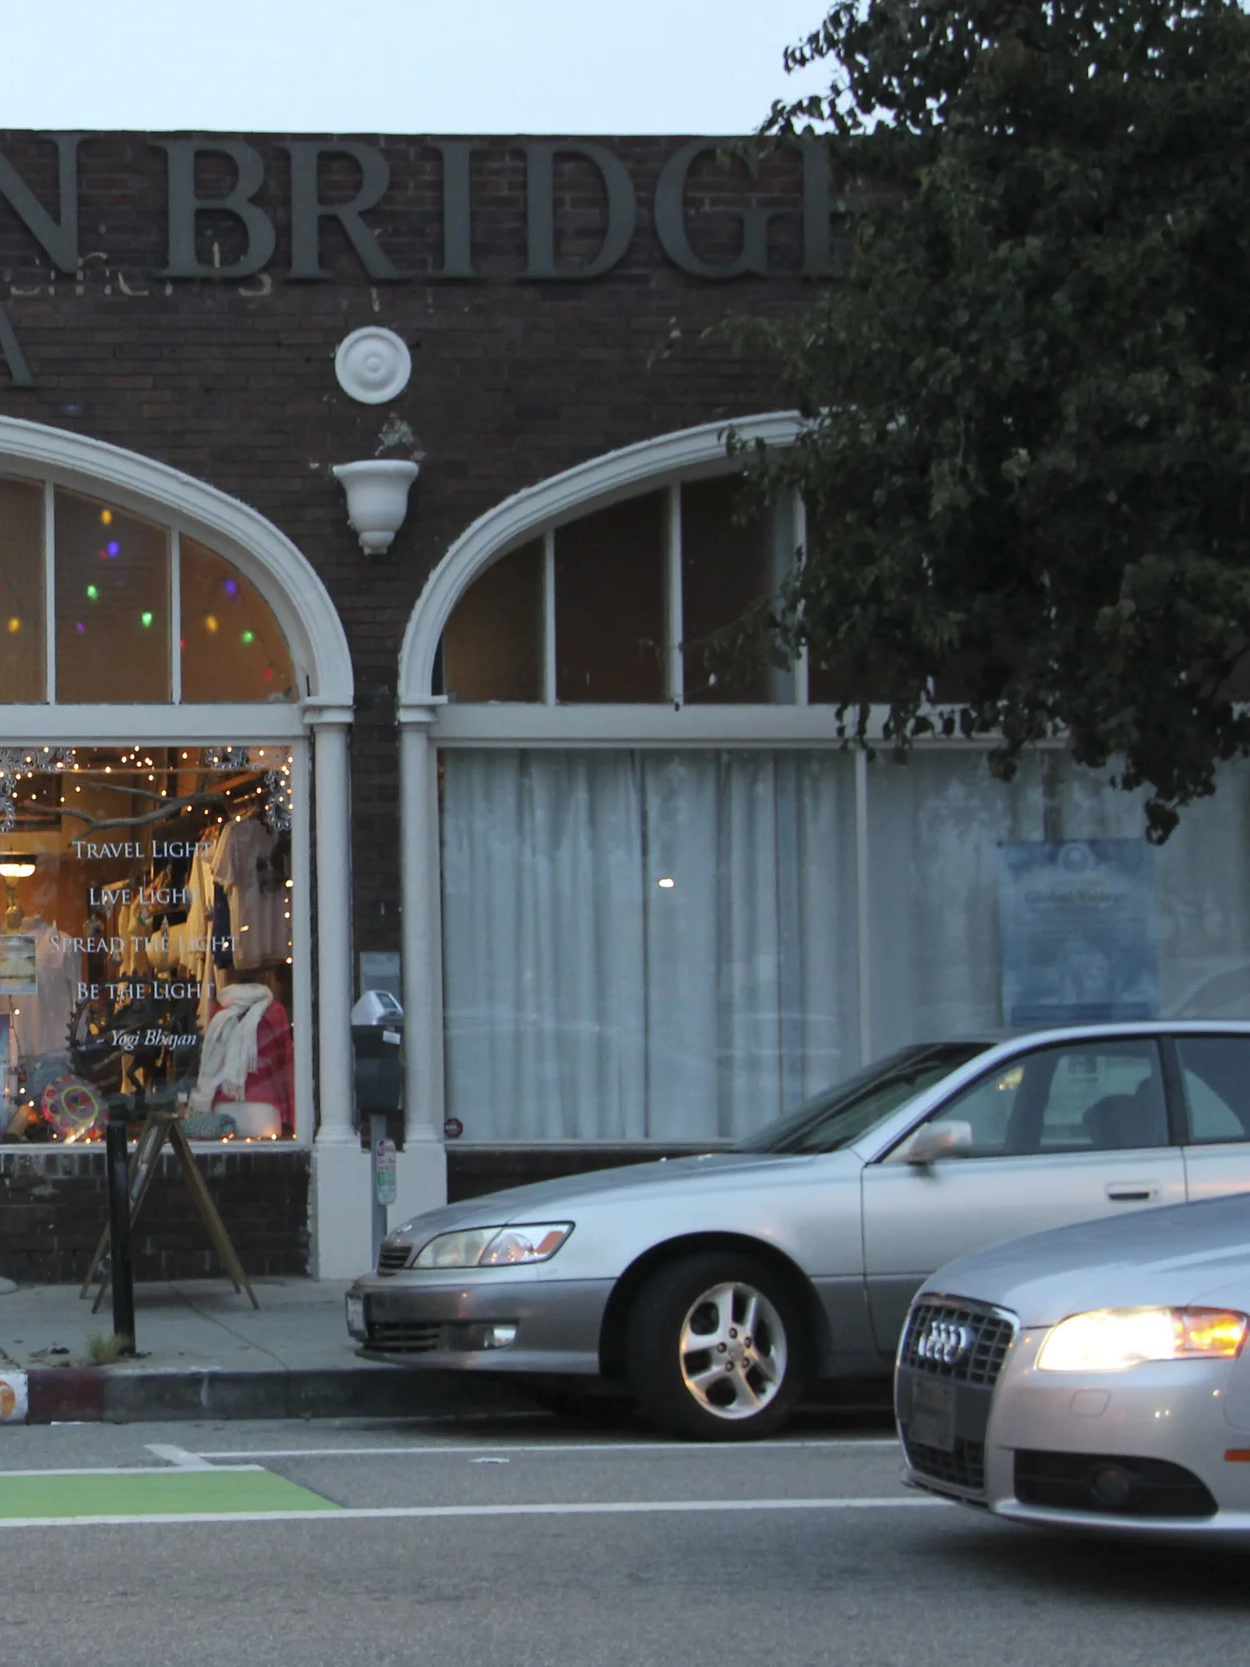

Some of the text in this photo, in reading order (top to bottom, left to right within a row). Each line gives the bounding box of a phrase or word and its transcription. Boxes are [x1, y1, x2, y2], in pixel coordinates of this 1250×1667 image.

[71, 840, 145, 860] TRAVEL
[105, 983, 145, 999] THE
[153, 980, 215, 1000] LIGHT
[111, 1029, 141, 1051] Yogi
[144, 1028, 198, 1050] Bhajan
